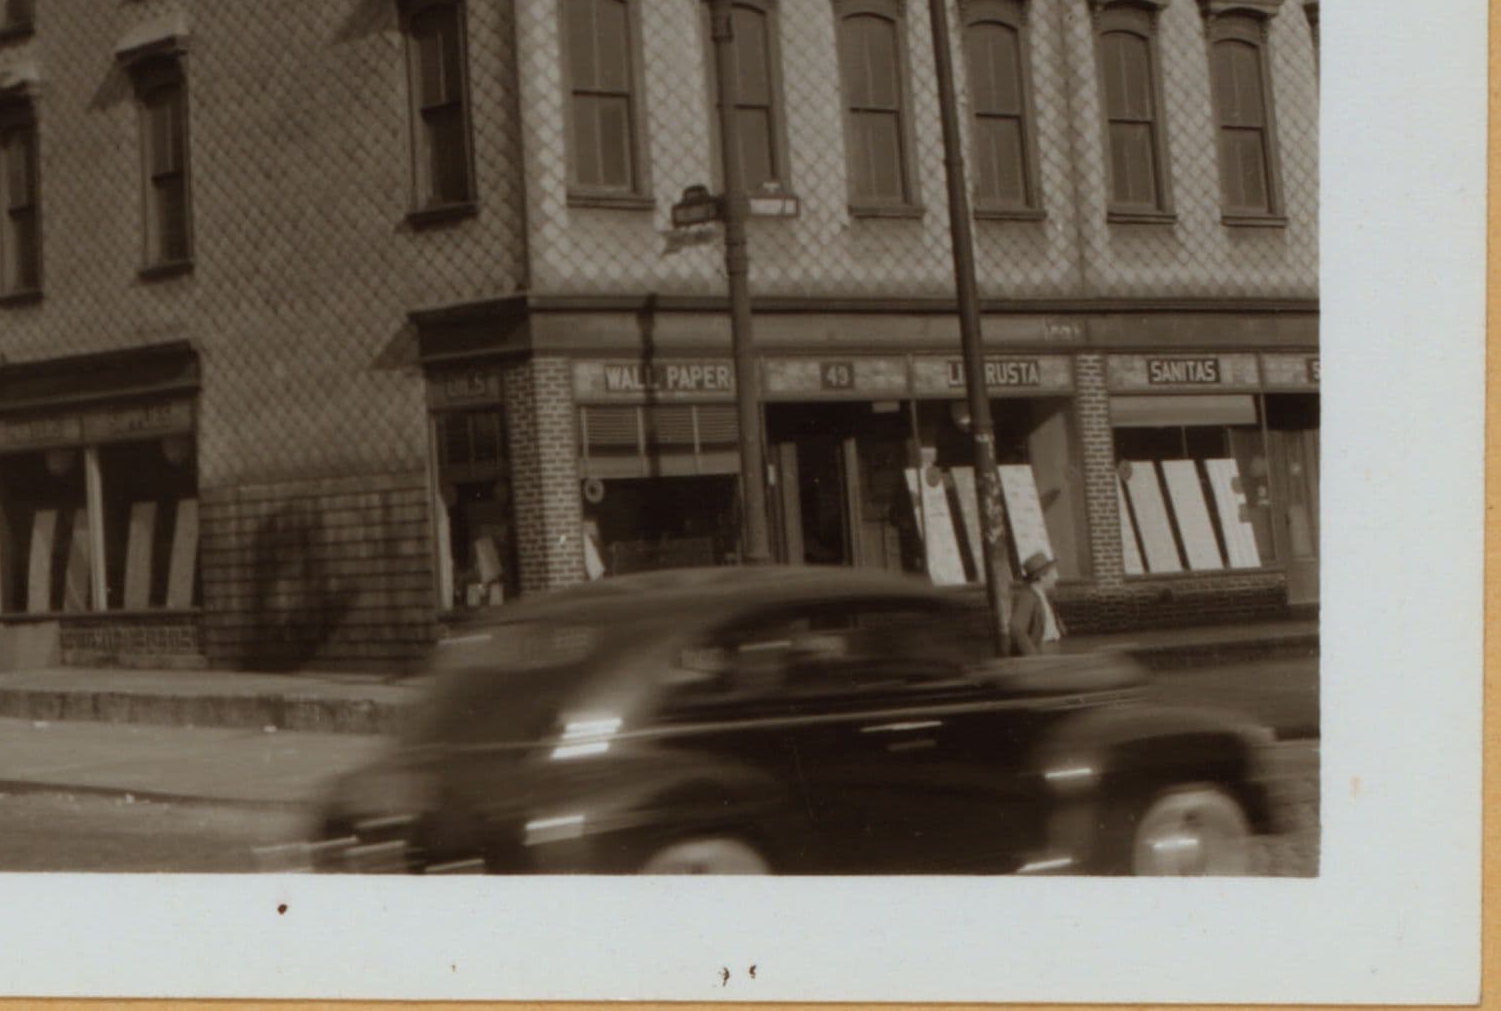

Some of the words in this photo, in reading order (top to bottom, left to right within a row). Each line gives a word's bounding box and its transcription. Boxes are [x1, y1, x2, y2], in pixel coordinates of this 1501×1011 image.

[605, 364, 660, 390] WALL
[666, 364, 730, 389] PAPER
[826, 364, 849, 387] 49
[947, 361, 1038, 384] LIRUSTA
[1150, 360, 1215, 382] SANITAS
